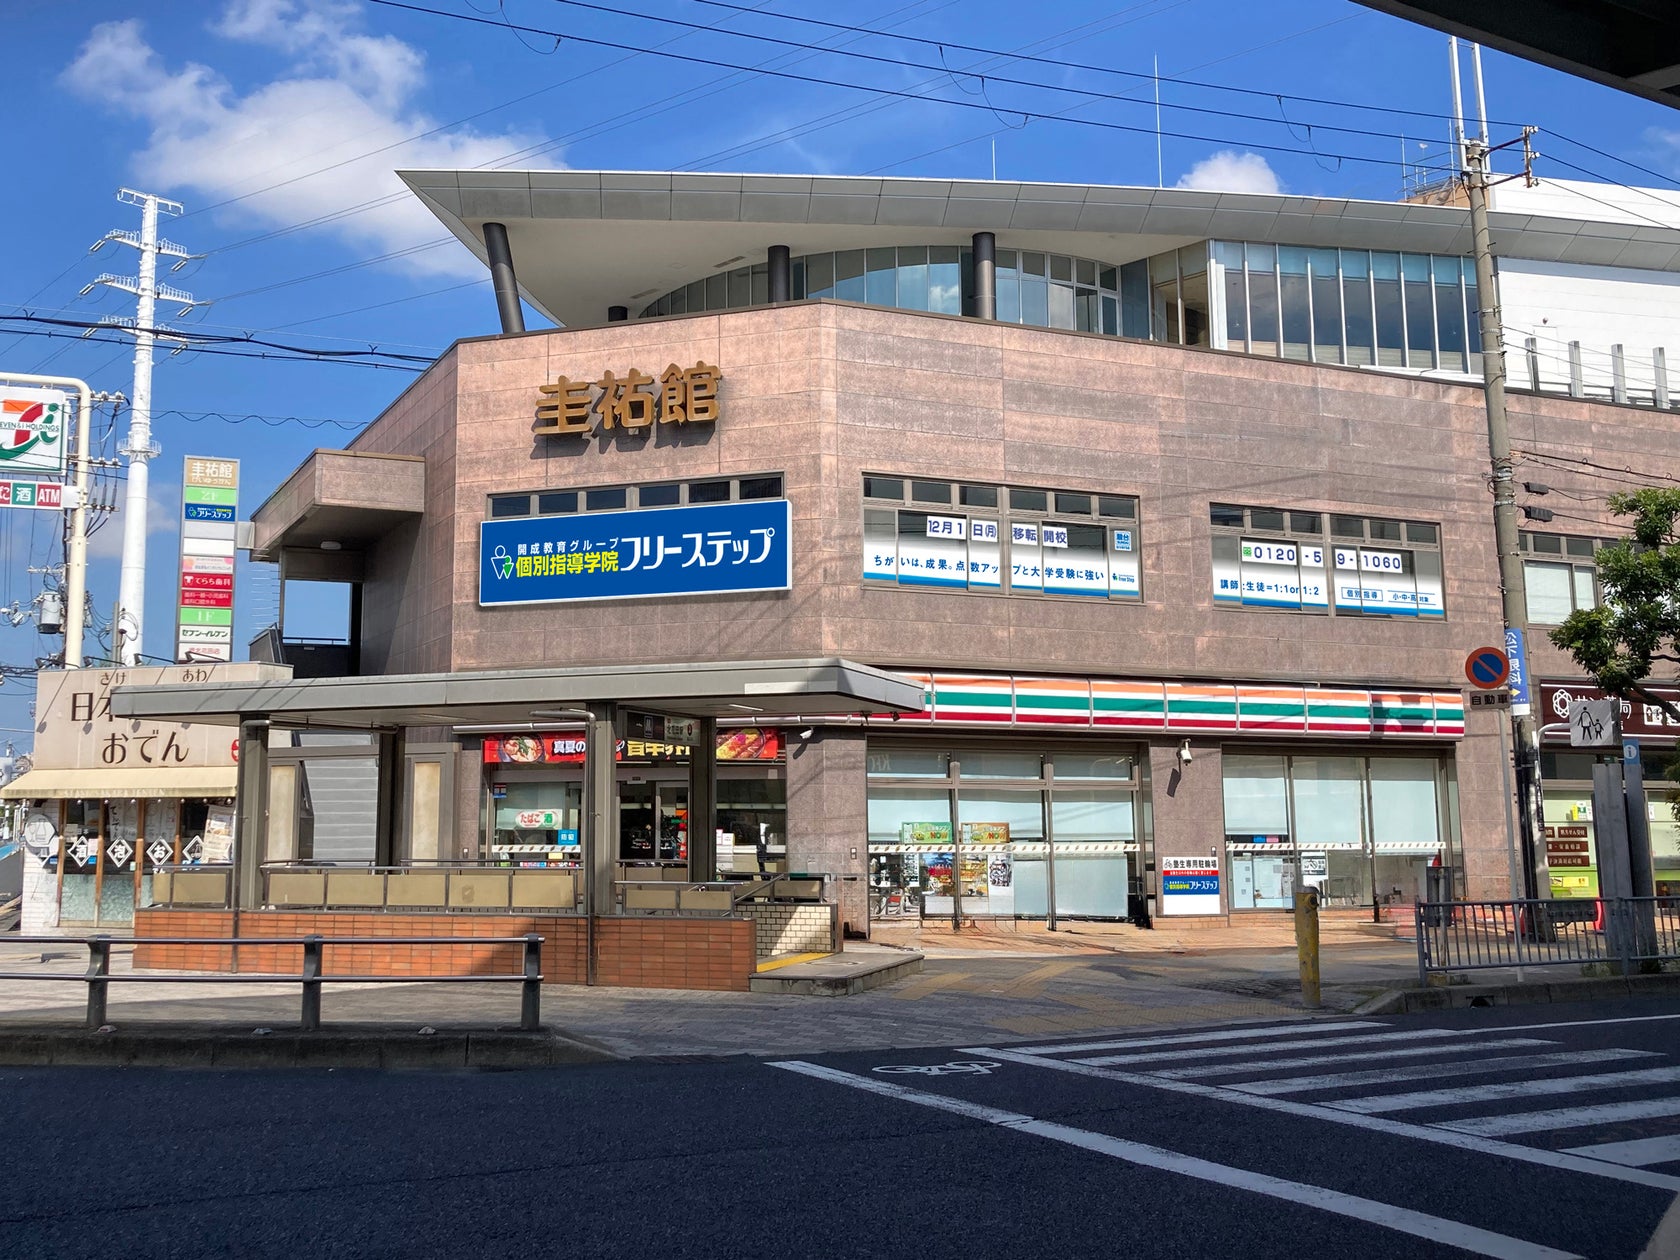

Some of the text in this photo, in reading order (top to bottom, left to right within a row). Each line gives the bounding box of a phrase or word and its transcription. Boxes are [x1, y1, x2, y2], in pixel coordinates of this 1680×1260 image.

[533, 360, 722, 435] 圭祐館
[192, 461, 233, 478] 圭祐館
[16, 487, 32, 502] 酒
[38, 488, 60, 503] ATM
[1012, 527, 1067, 544] 移転開校
[517, 537, 619, 555] 開成教育グループ
[620, 527, 776, 572] フリーステップ
[516, 551, 619, 577] 個別指導学院
[99, 672, 127, 686] さけ
[182, 668, 207, 683] あわ
[1471, 694, 1508, 706] 自動車
[102, 729, 190, 764] おでん
[553, 740, 586, 753] 真夏の
[520, 813, 541, 824] たばこ
